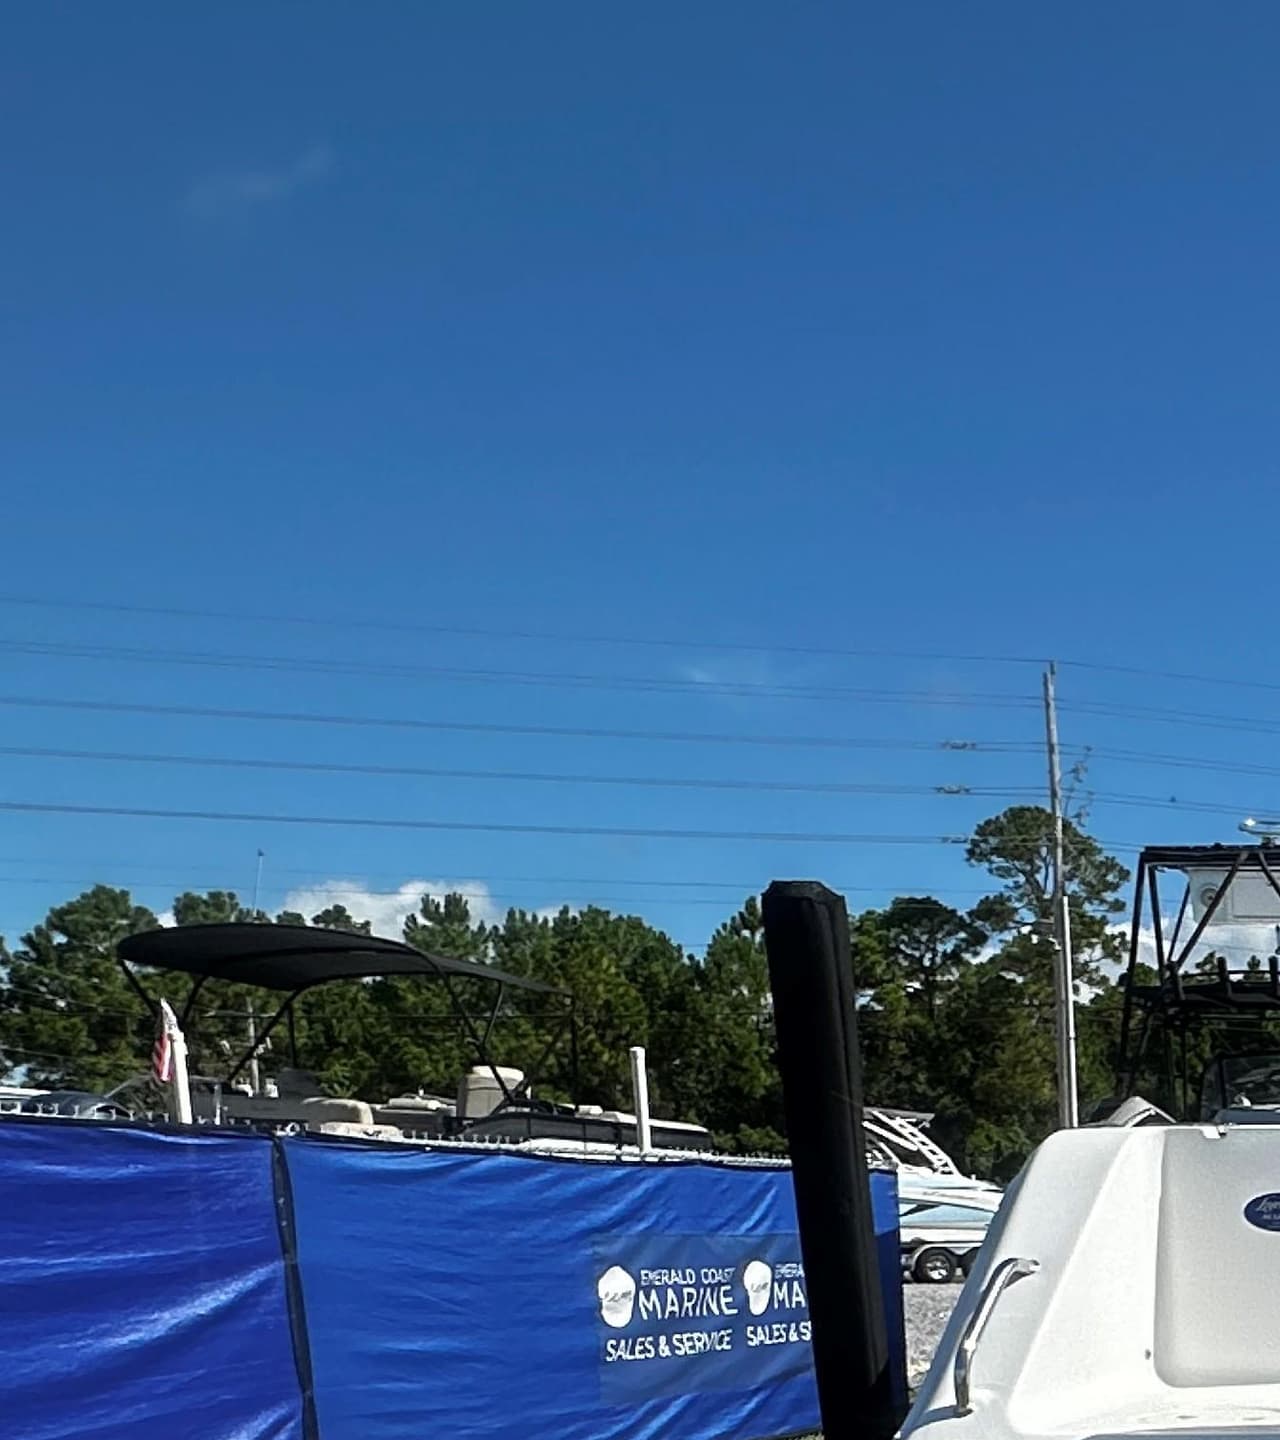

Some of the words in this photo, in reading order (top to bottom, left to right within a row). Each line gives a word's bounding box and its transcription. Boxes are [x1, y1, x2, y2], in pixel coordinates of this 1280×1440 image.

[640, 1268, 696, 1286] EMERALD
[700, 1266, 737, 1284] COAST
[638, 1285, 739, 1321] MARINE
[605, 1337, 655, 1362] SALES
[658, 1335, 672, 1358] &
[672, 1328, 733, 1356] SERVICE
[746, 1323, 786, 1347] SALES
[789, 1321, 800, 1342] &
[799, 1319, 812, 1342] S
